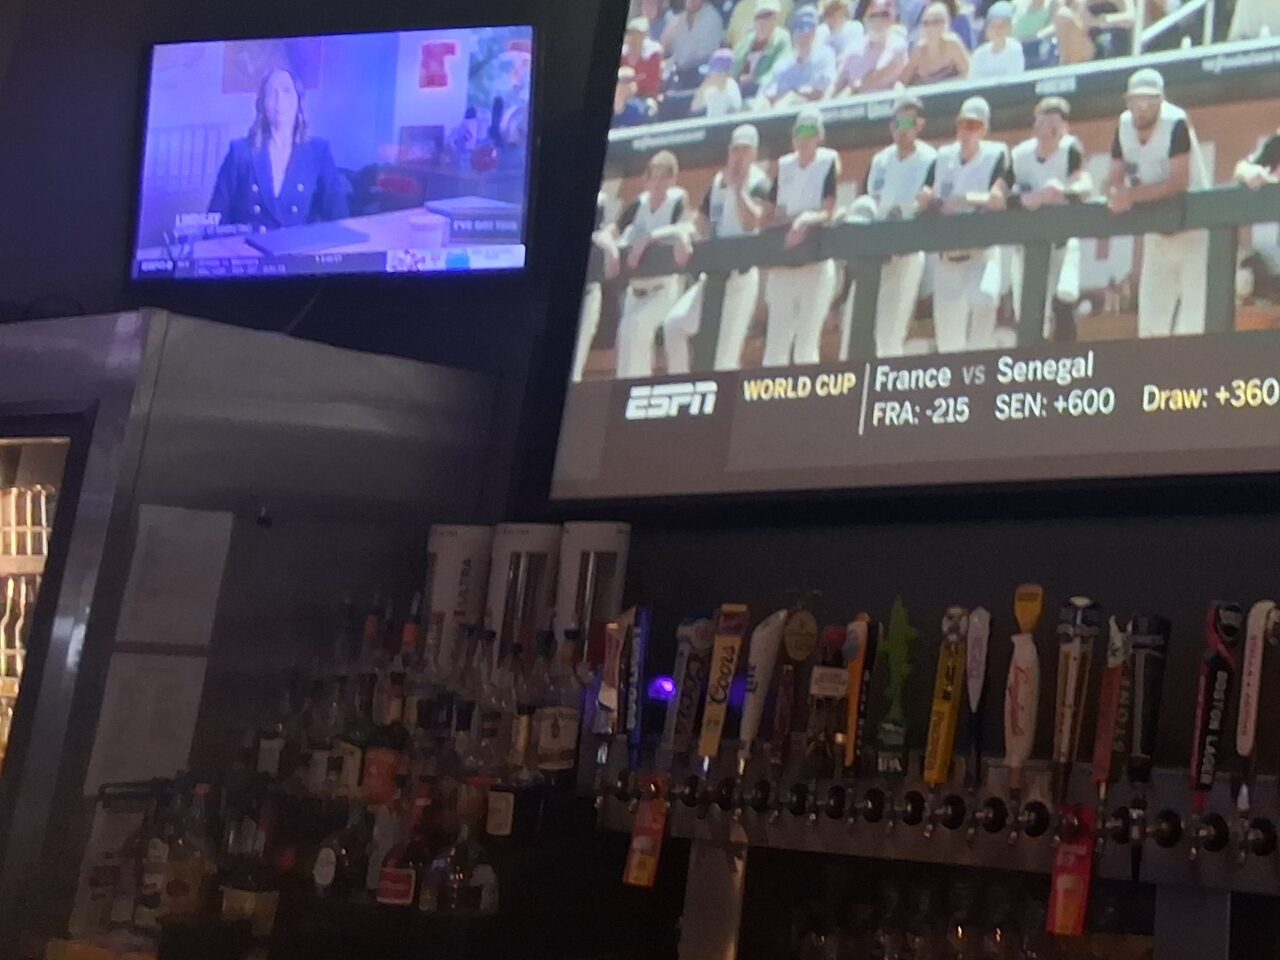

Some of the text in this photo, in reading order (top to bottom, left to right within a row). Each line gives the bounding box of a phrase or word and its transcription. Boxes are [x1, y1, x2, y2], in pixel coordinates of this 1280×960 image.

[743, 372, 857, 402] WORLD CUP
[874, 365, 951, 392] France
[995, 351, 1094, 385] Senegal
[625, 381, 718, 420] ESPN
[872, 401, 919, 427] FRA:
[925, 397, 970, 424] -215
[994, 393, 1047, 420] SEN:
[1053, 386, 1115, 417] +600
[1143, 385, 1208, 412] Draw:
[1215, 377, 1280, 408] +360
[709, 643, 737, 705] Coors
